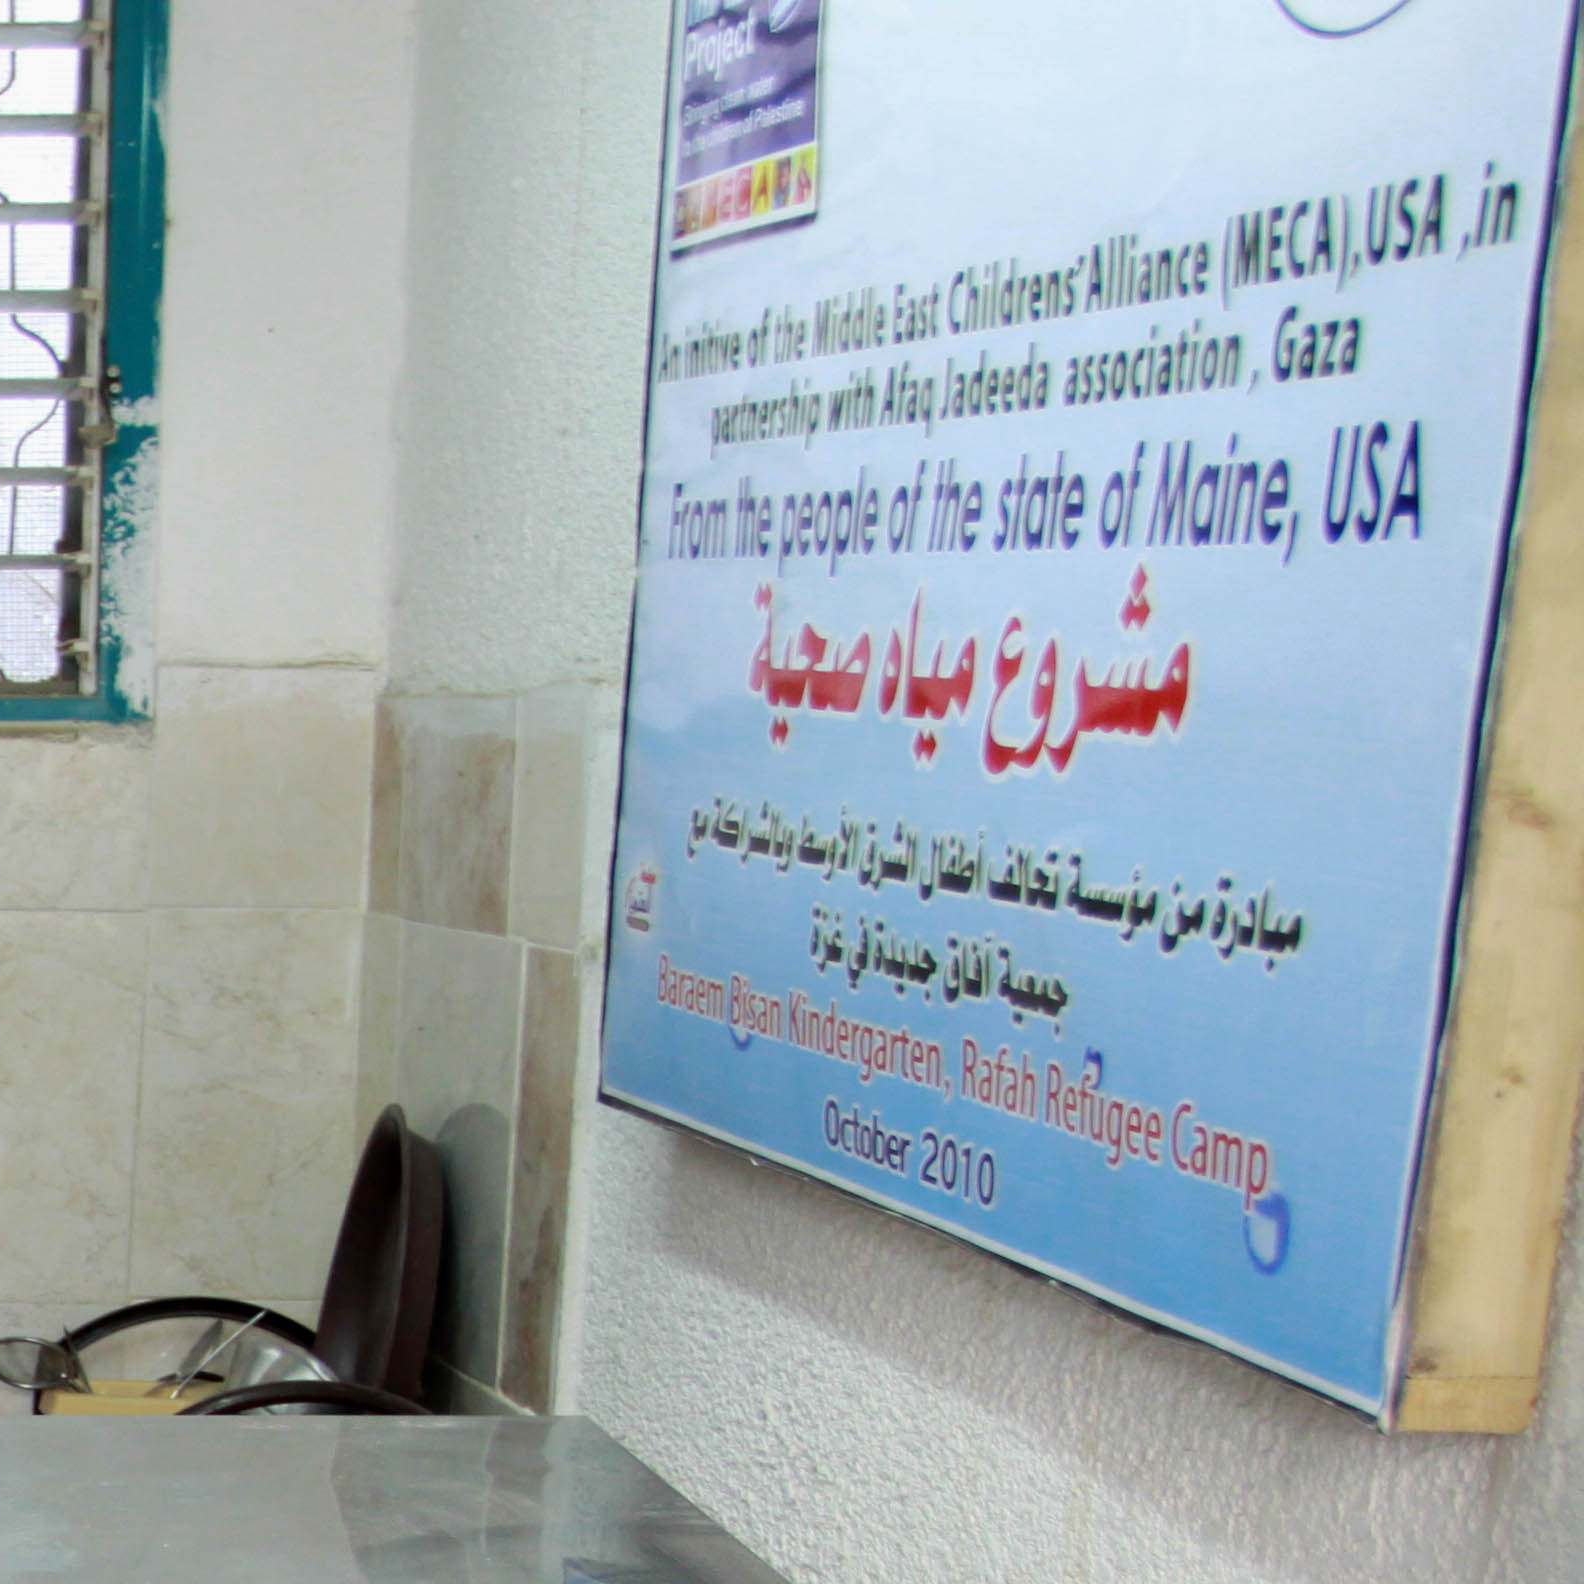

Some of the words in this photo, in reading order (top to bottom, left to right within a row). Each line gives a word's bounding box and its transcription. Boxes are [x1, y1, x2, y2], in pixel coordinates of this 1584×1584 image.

[684, 7, 756, 82] Project
[747, 307, 772, 369] of
[774, 303, 806, 365] the
[812, 285, 886, 358] Middle
[891, 281, 939, 345] East
[710, 377, 822, 460] partnership
[826, 367, 875, 433] with
[879, 359, 935, 439] Afaq
[939, 342, 1049, 421] Jadeeda
[1270, 304, 1359, 384] Gaza
[669, 482, 728, 560] From
[735, 475, 772, 557] the
[778, 465, 878, 578] people
[887, 459, 926, 555] of
[927, 457, 982, 553] the
[992, 450, 1084, 551] state
[1097, 439, 1144, 550] of
[1145, 431, 1298, 568] Maine,
[1320, 419, 1422, 545] USA
[747, 581, 871, 745] صحية
[878, 587, 975, 762] مياه
[982, 562, 1189, 775] مشروع
[687, 808, 708, 860] مع
[810, 903, 844, 976] غزة
[1066, 853, 1158, 943] مؤسسة
[1159, 881, 1205, 954] من
[1210, 876, 1303, 973] مبادرة
[847, 914, 869, 991] في
[873, 919, 938, 1003] جديدة
[997, 945, 1068, 1037] جمعية
[657, 953, 725, 1022] Baraem
[730, 974, 782, 1038] Bisan
[787, 990, 952, 1098] Kindergarten,
[961, 1038, 1036, 1119] Rafah
[1045, 1062, 1162, 1167] Refugee
[1171, 1103, 1269, 1211] Camp
[823, 1099, 911, 1174] October
[919, 1131, 996, 1207] 2010
